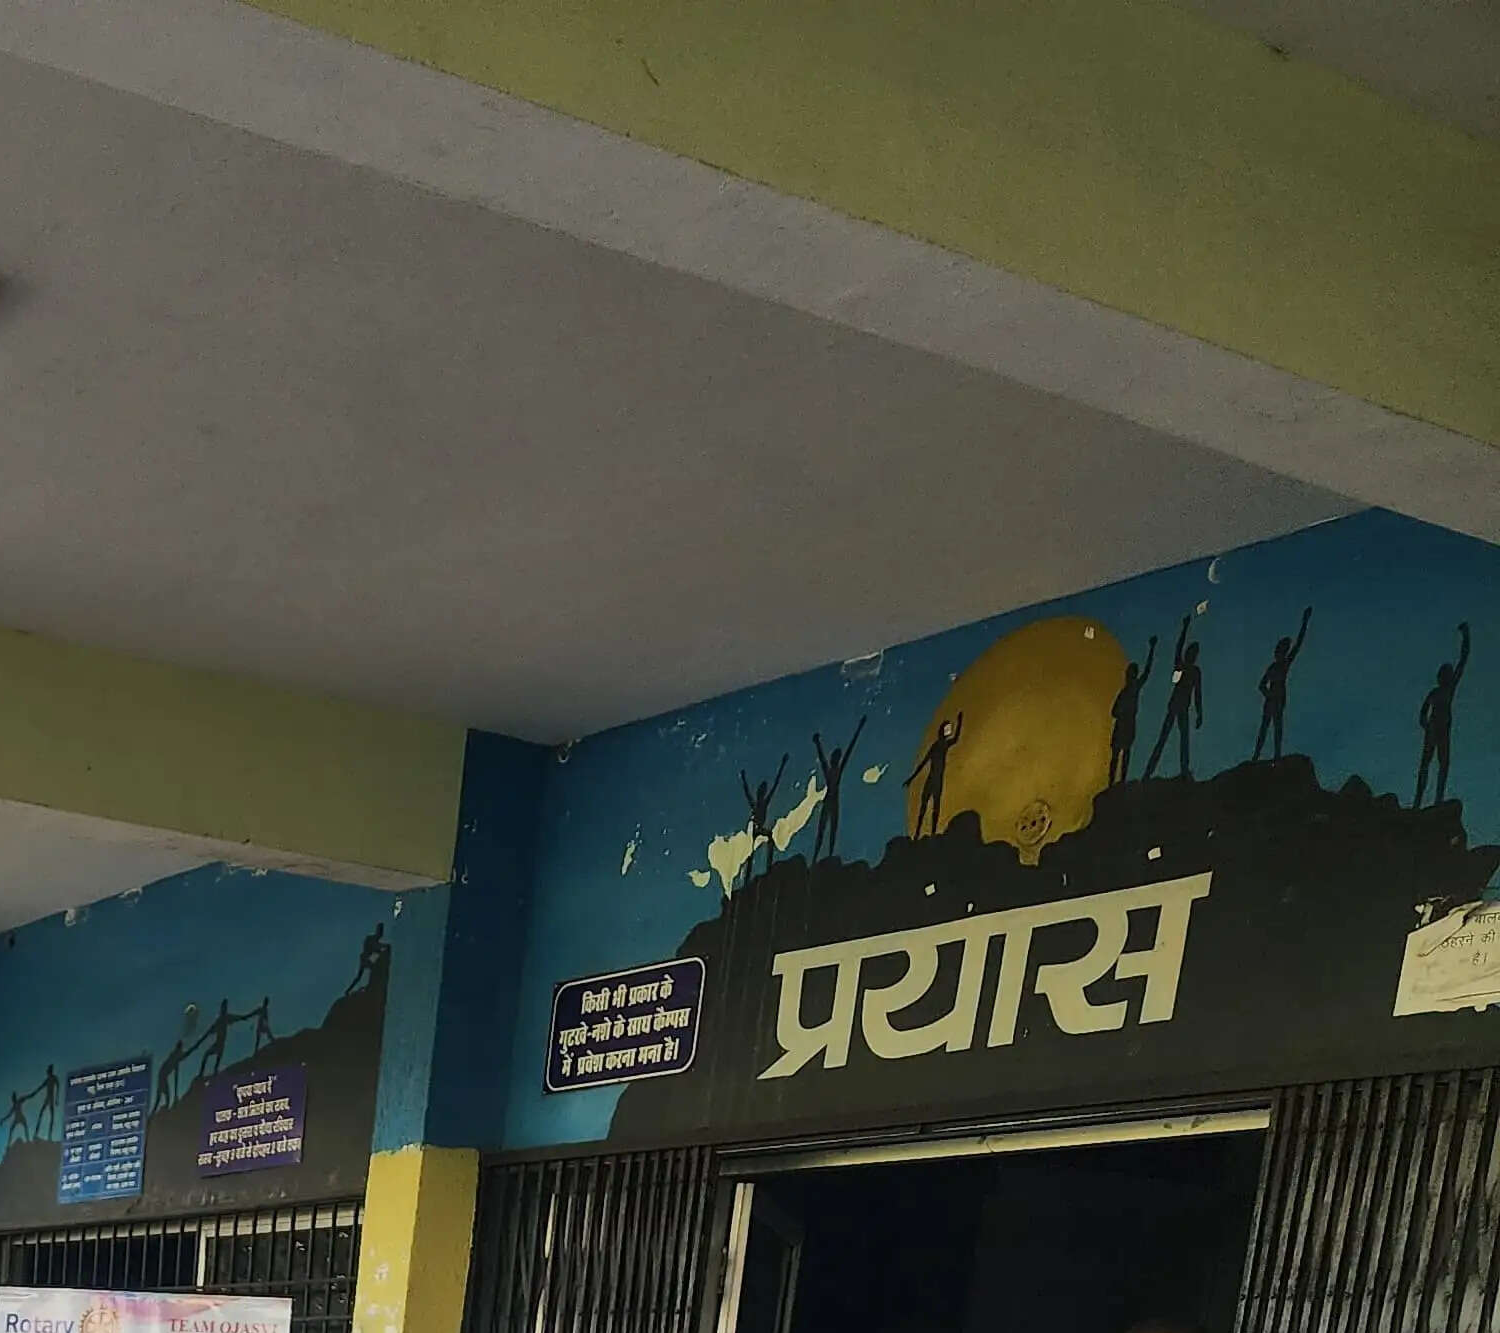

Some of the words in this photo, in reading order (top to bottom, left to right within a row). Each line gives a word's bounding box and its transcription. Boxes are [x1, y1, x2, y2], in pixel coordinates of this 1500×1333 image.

[756, 872, 1212, 1080] प्रयास
[581, 987, 611, 1014] किसी
[612, 984, 627, 1008] भी
[628, 982, 659, 1006] प्रकार
[659, 974, 674, 999] के
[613, 1014, 626, 1039] के
[627, 1015, 652, 1037] साथ
[653, 1006, 691, 1031] कैम्पस
[562, 1052, 575, 1077] में
[577, 1050, 603, 1076] प्रवेश
[605, 1048, 637, 1070] करना
[637, 1044, 663, 1065] मना
[170, 1319, 215, 1333] TEAM
